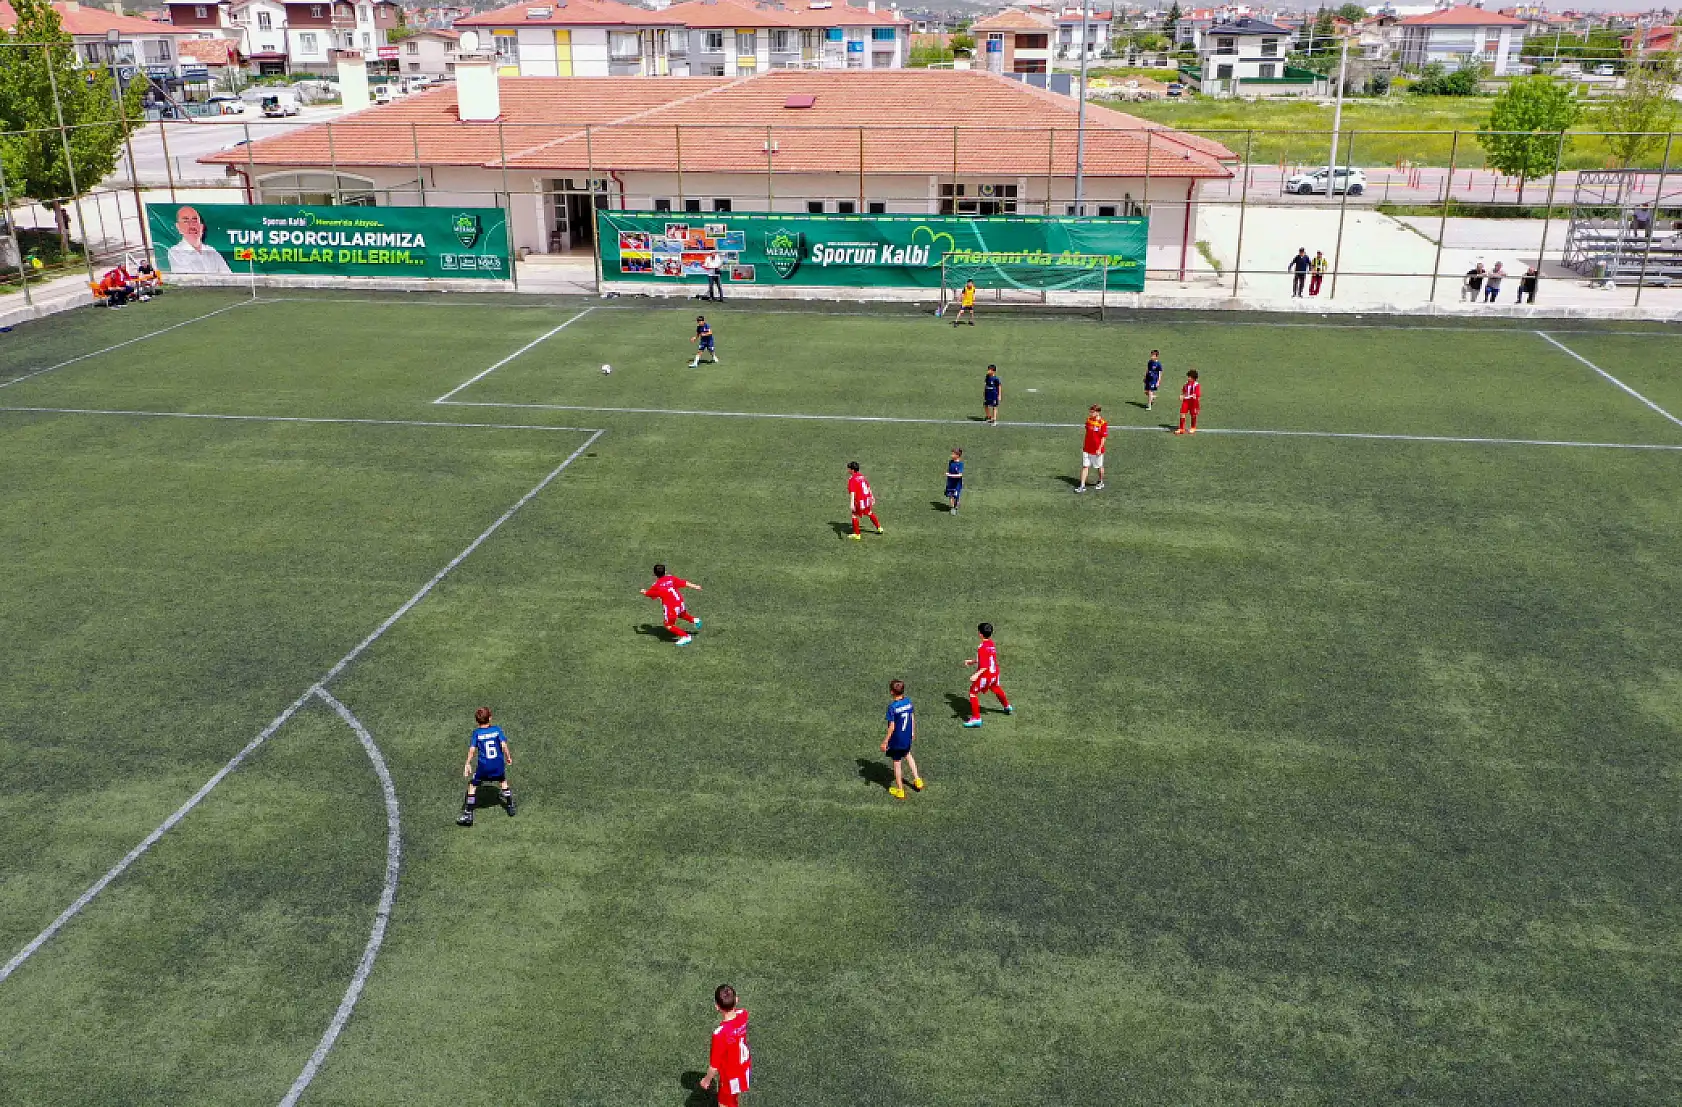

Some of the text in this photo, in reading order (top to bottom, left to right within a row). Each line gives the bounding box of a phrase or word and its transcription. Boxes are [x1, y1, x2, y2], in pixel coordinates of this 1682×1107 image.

[268, 230, 426, 248] SPORCULARIMIZA
[812, 243, 876, 267] Sporun
[880, 244, 931, 265] Kalbi
[900, 711, 908, 732] 7
[485, 740, 498, 759] 6
